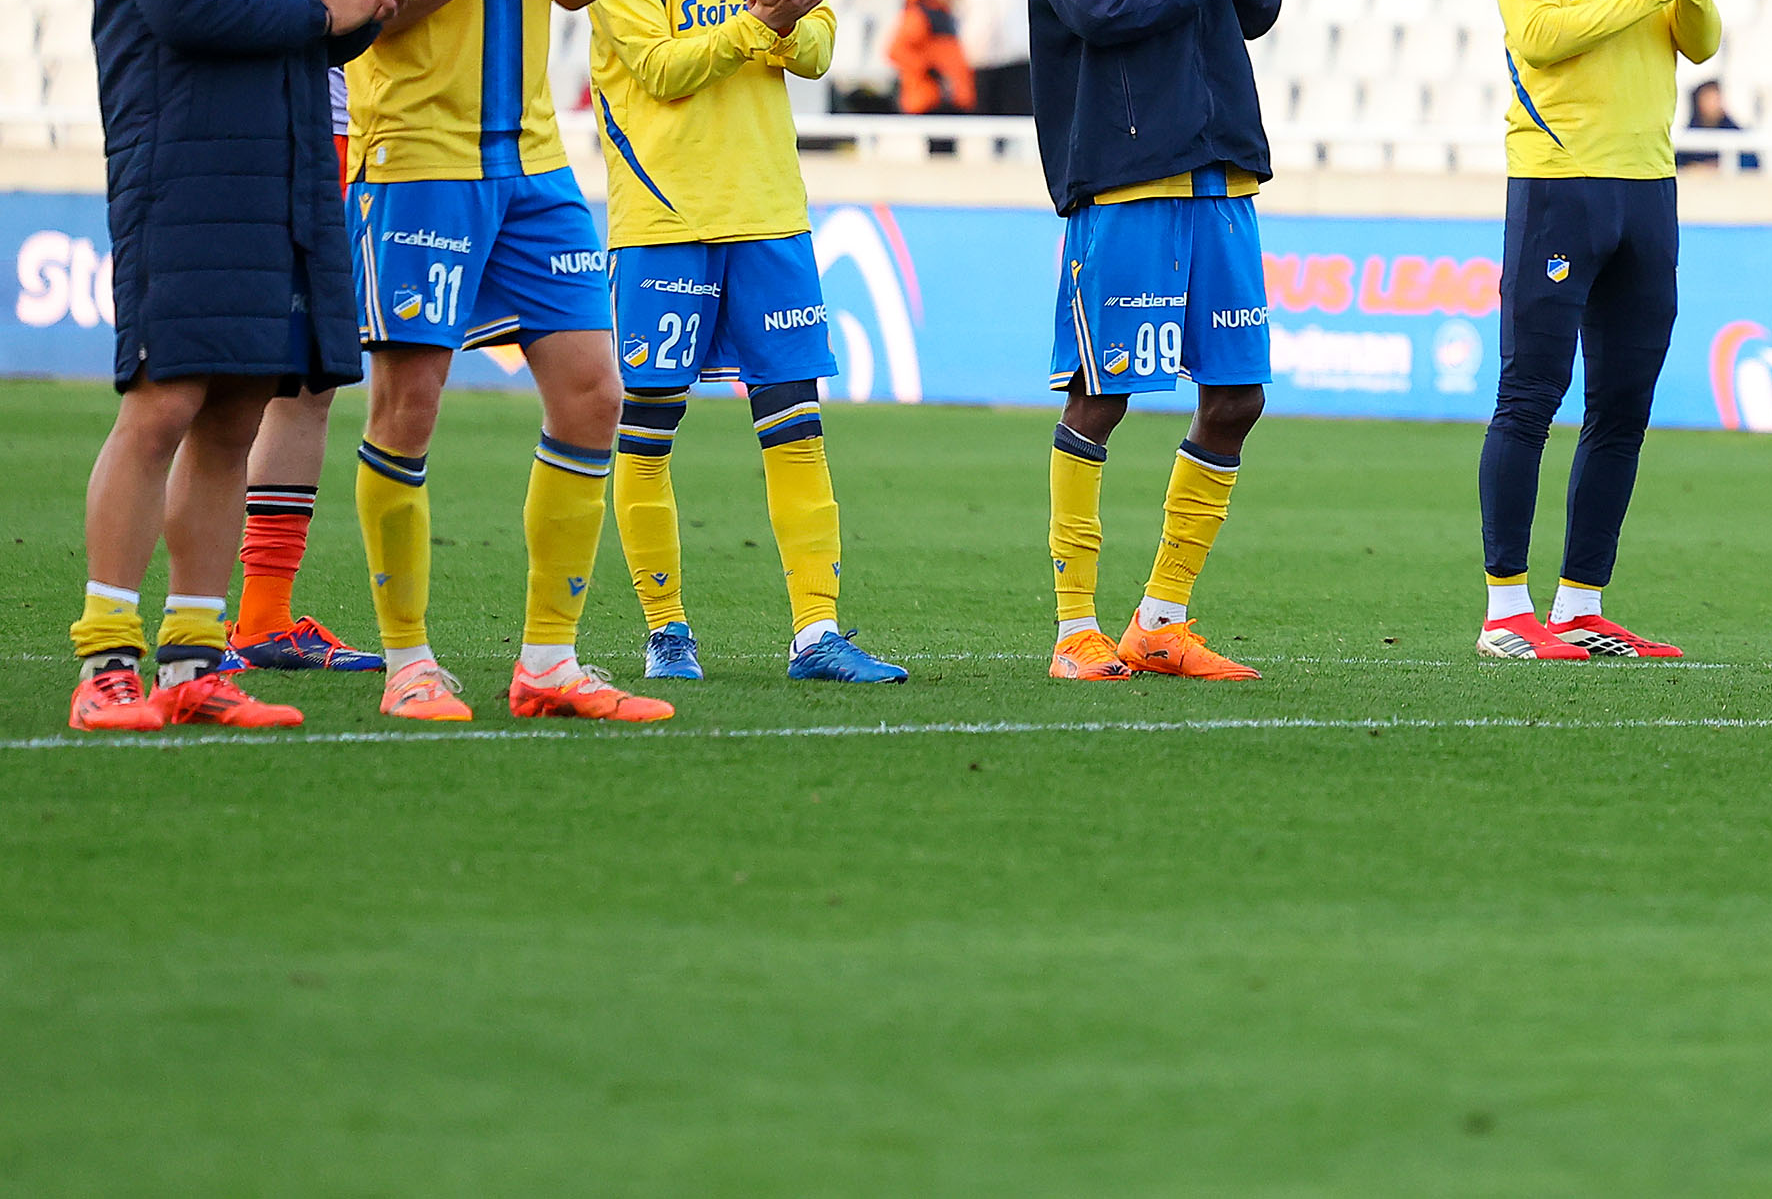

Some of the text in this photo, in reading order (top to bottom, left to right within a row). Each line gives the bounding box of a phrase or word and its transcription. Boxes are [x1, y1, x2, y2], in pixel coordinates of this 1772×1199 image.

[550, 251, 608, 275] NURO
[425, 262, 464, 327] 31
[655, 312, 700, 369] 23
[1134, 322, 1183, 376] 99
